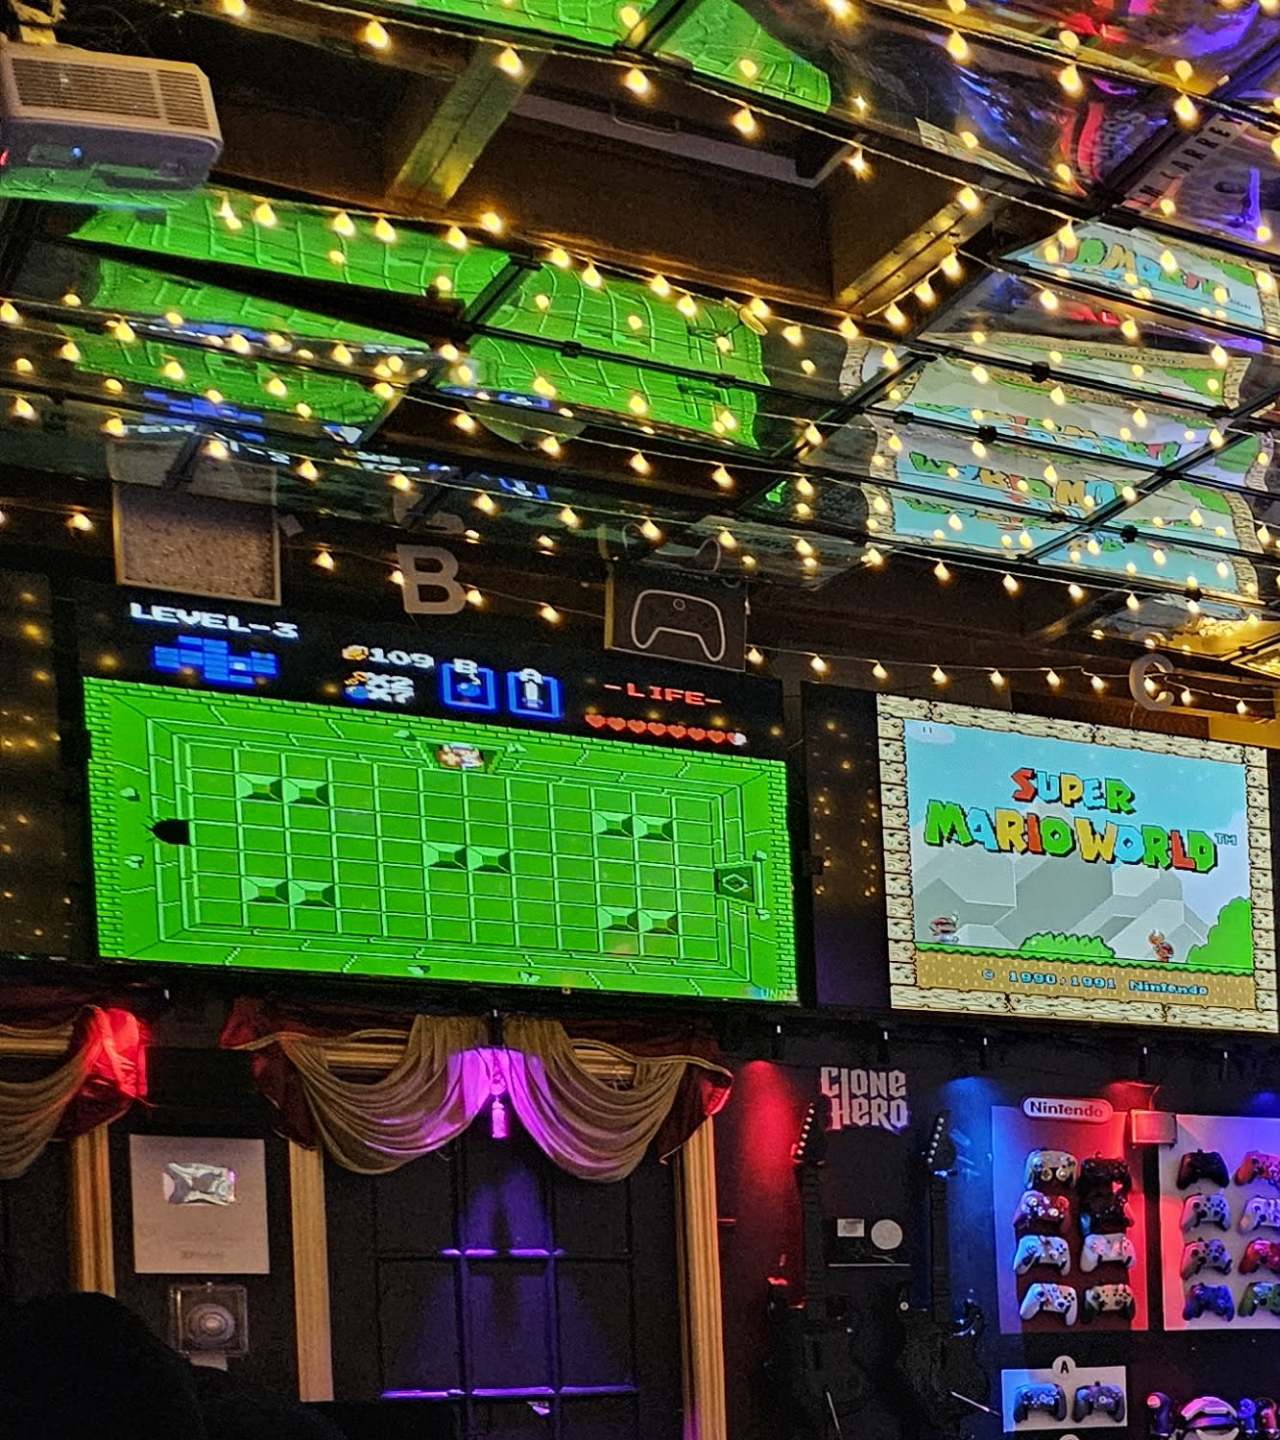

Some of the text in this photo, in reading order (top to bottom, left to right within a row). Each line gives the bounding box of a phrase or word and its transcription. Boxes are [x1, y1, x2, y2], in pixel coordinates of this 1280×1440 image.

[129, 602, 299, 639] LEVEL-3
[369, 647, 435, 669] 109
[604, 682, 722, 706] -LIFE-
[1011, 767, 1136, 814] SUPER
[924, 799, 1075, 856] MARIO
[1074, 815, 1218, 874] WORLD
[1128, 979, 1209, 996] Nintendo
[1029, 1099, 1104, 1118] Nintendo
[1061, 1361, 1070, 1374] A
